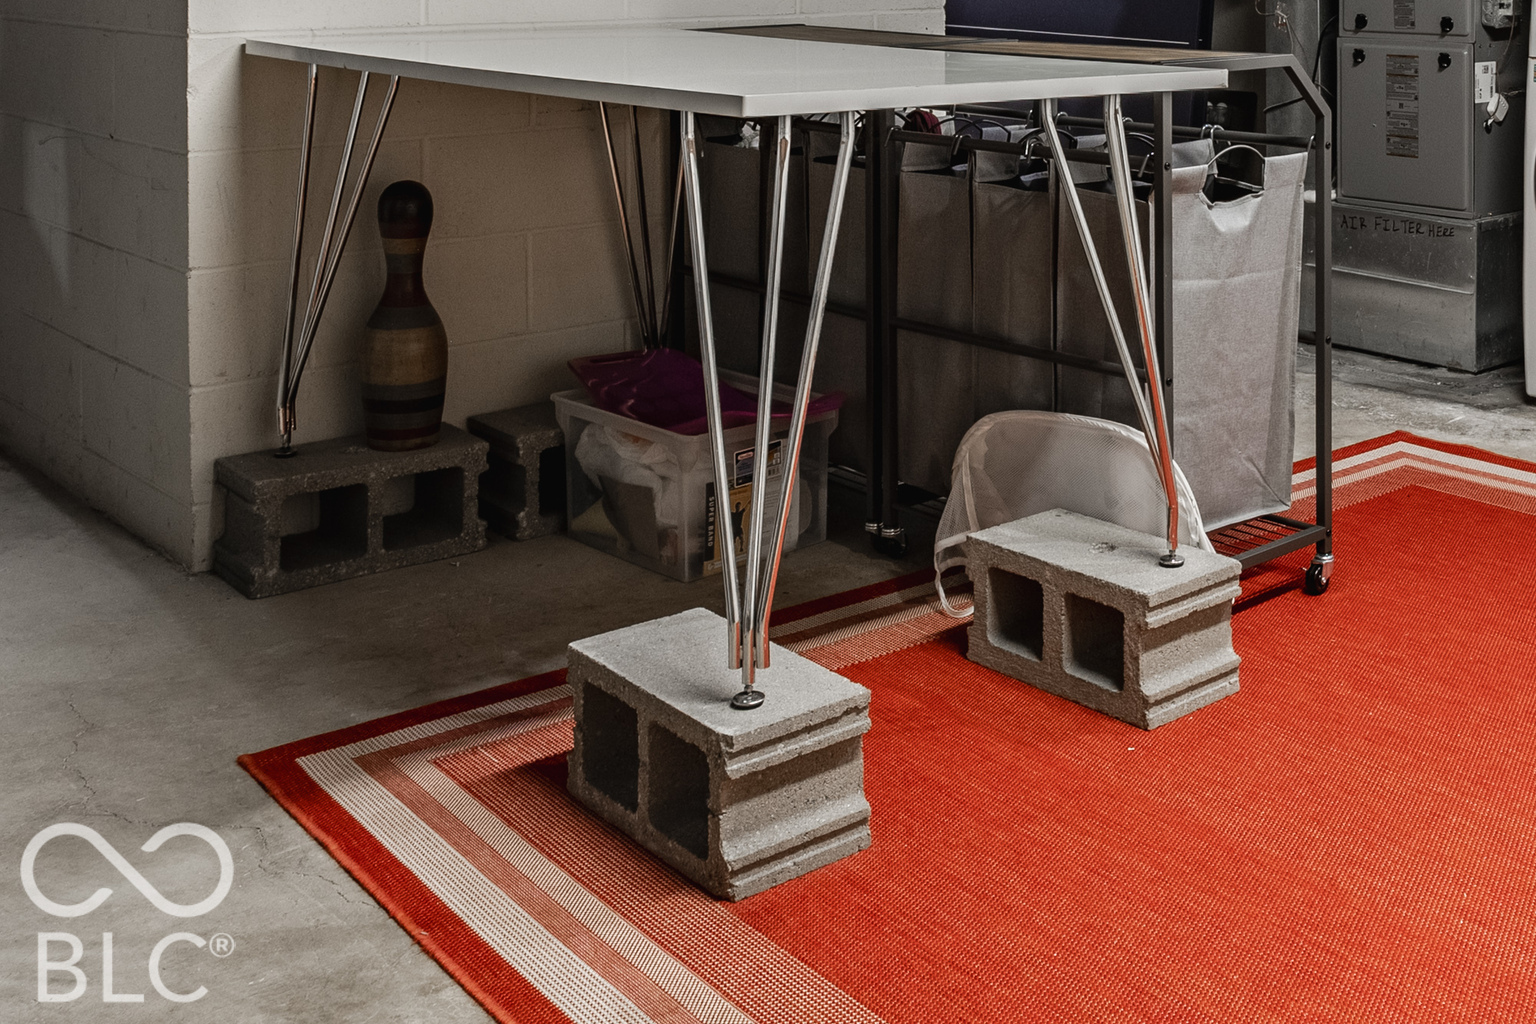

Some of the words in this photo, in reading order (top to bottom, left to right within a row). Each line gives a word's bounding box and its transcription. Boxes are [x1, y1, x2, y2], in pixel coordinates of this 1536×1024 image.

[1340, 214, 1367, 230] AIR
[1374, 216, 1424, 235] FILTER
[1428, 224, 1455, 237] HERE
